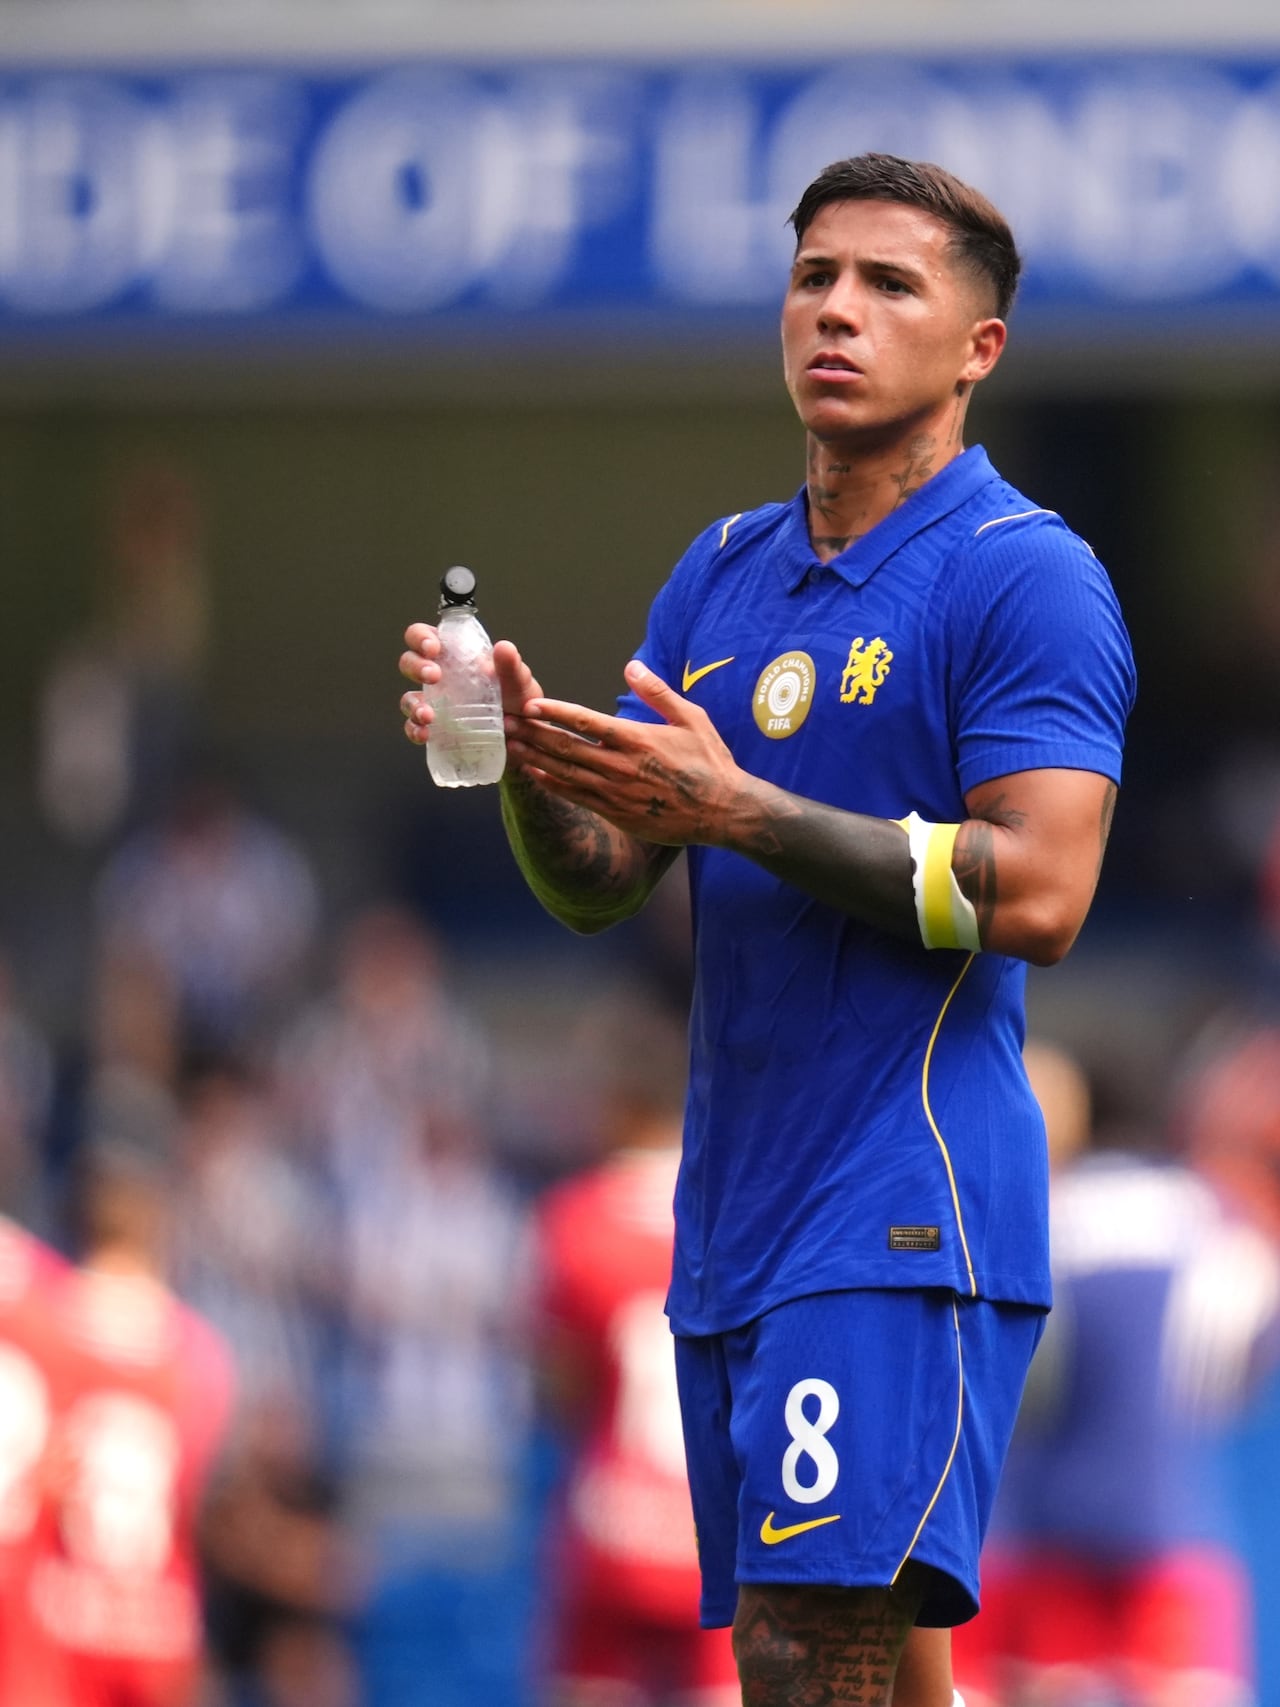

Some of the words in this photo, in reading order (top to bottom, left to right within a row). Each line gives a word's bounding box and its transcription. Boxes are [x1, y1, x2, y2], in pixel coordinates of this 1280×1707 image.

[308, 66, 642, 316] OF
[757, 665, 781, 705] WORLD
[781, 658, 811, 703] CHAMPIONS
[767, 717, 791, 731] FIFA
[781, 1378, 840, 1504] 8
